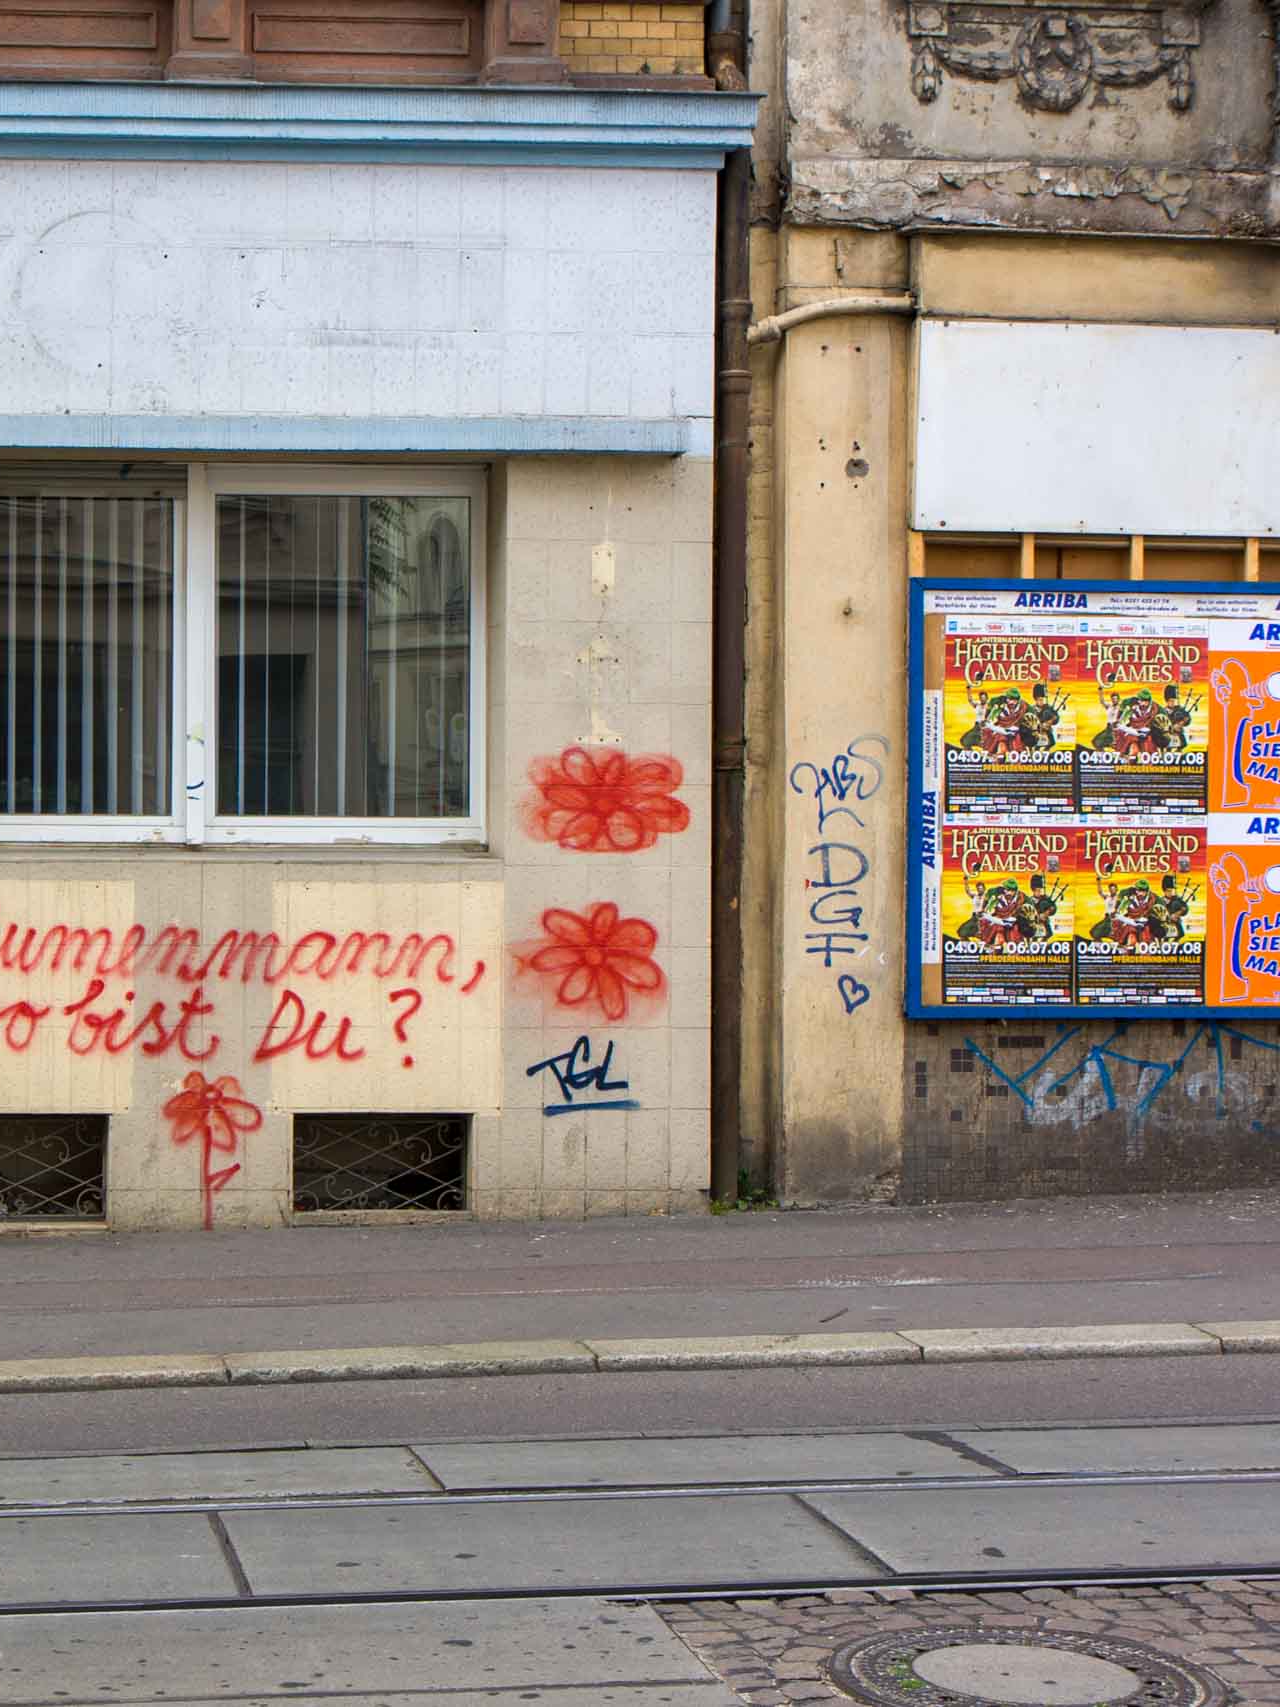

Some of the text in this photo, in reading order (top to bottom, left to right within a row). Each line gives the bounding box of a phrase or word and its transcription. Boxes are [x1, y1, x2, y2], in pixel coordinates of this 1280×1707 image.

[1014, 592, 1088, 608] ARRIBA
[953, 638, 1069, 668] HIGHLAND
[1085, 640, 1200, 669] HIGHLAND
[965, 658, 1041, 687] GAMES
[1096, 659, 1174, 688] GAMES
[1009, 750, 1073, 764] 06.07.08
[1250, 742, 1280, 757] SIE
[1141, 752, 1205, 765] 06.07.08
[1050, 764, 1073, 772] HALLE
[1182, 766, 1204, 774] HALLE
[921, 791, 936, 869] ARRIBA
[951, 829, 1069, 858] HIGHLAND
[1084, 830, 1199, 859] HIGHLAND
[962, 848, 1039, 877] GAMES
[1095, 849, 1171, 878] GAMES
[1007, 941, 1070, 954] 06.07.08
[1139, 942, 1201, 954] 06.07.08
[1249, 936, 1280, 951] SIE
[1047, 954, 1070, 963] HALLE
[1179, 955, 1201, 964] HALLE
[64, 979, 222, 1061] bist
[253, 987, 423, 1068] Du?
